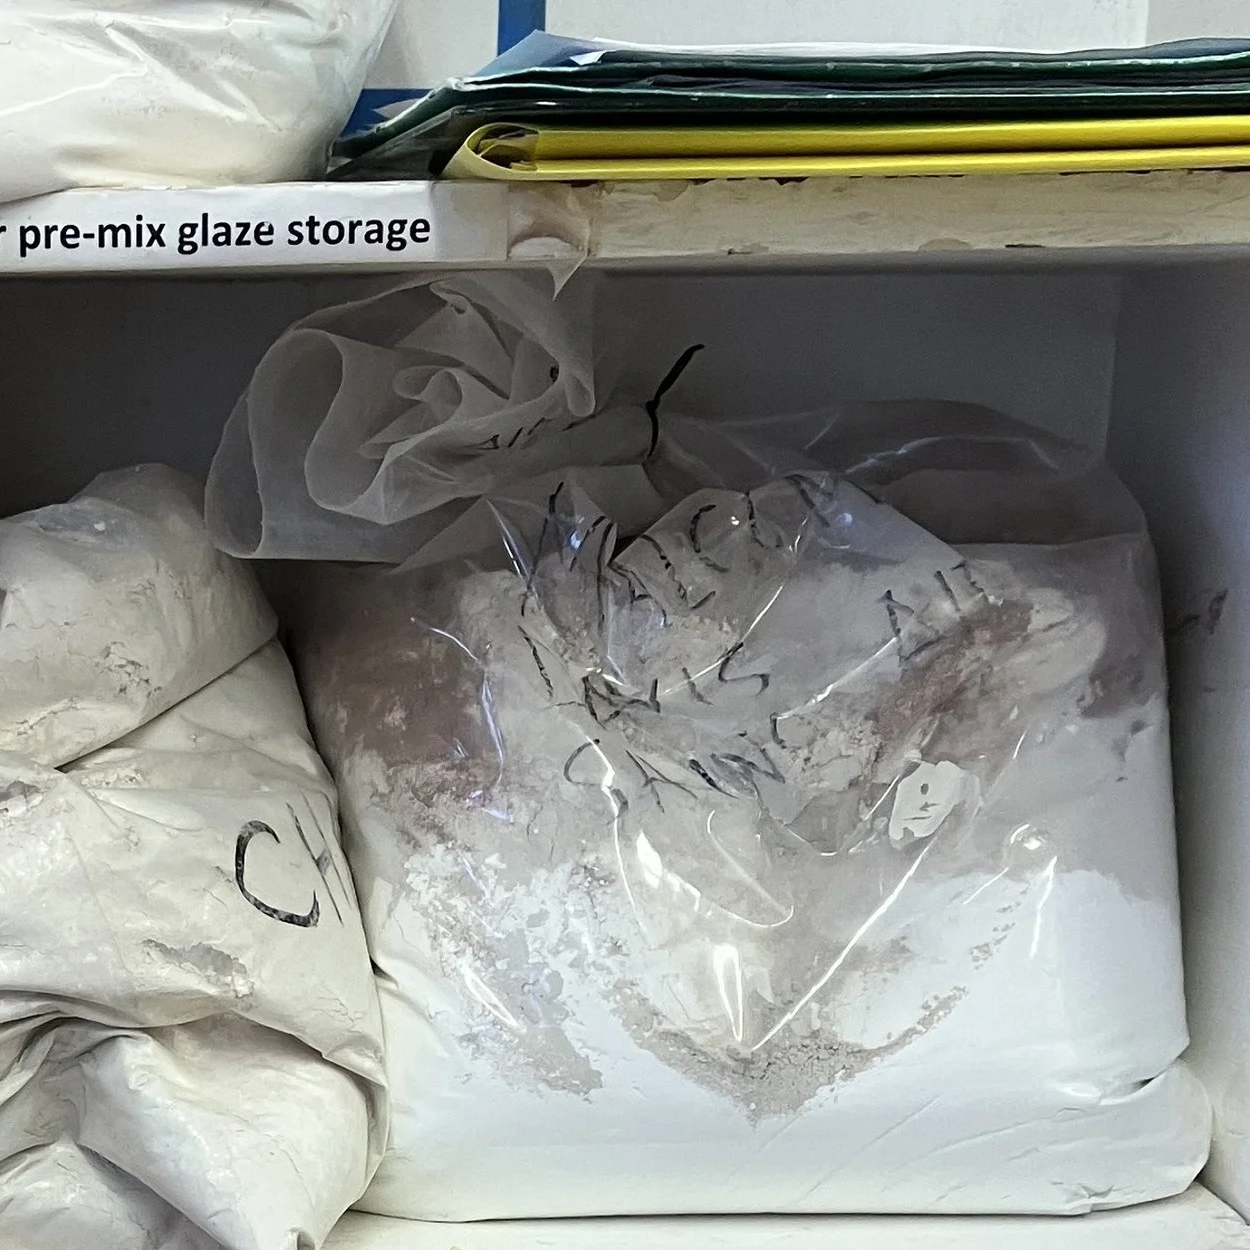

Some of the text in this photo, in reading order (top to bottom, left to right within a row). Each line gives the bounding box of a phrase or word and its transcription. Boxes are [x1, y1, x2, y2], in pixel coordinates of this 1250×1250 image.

[19, 213, 167, 258] pre-mix
[177, 212, 275, 255] glaze
[287, 215, 431, 252] storage
